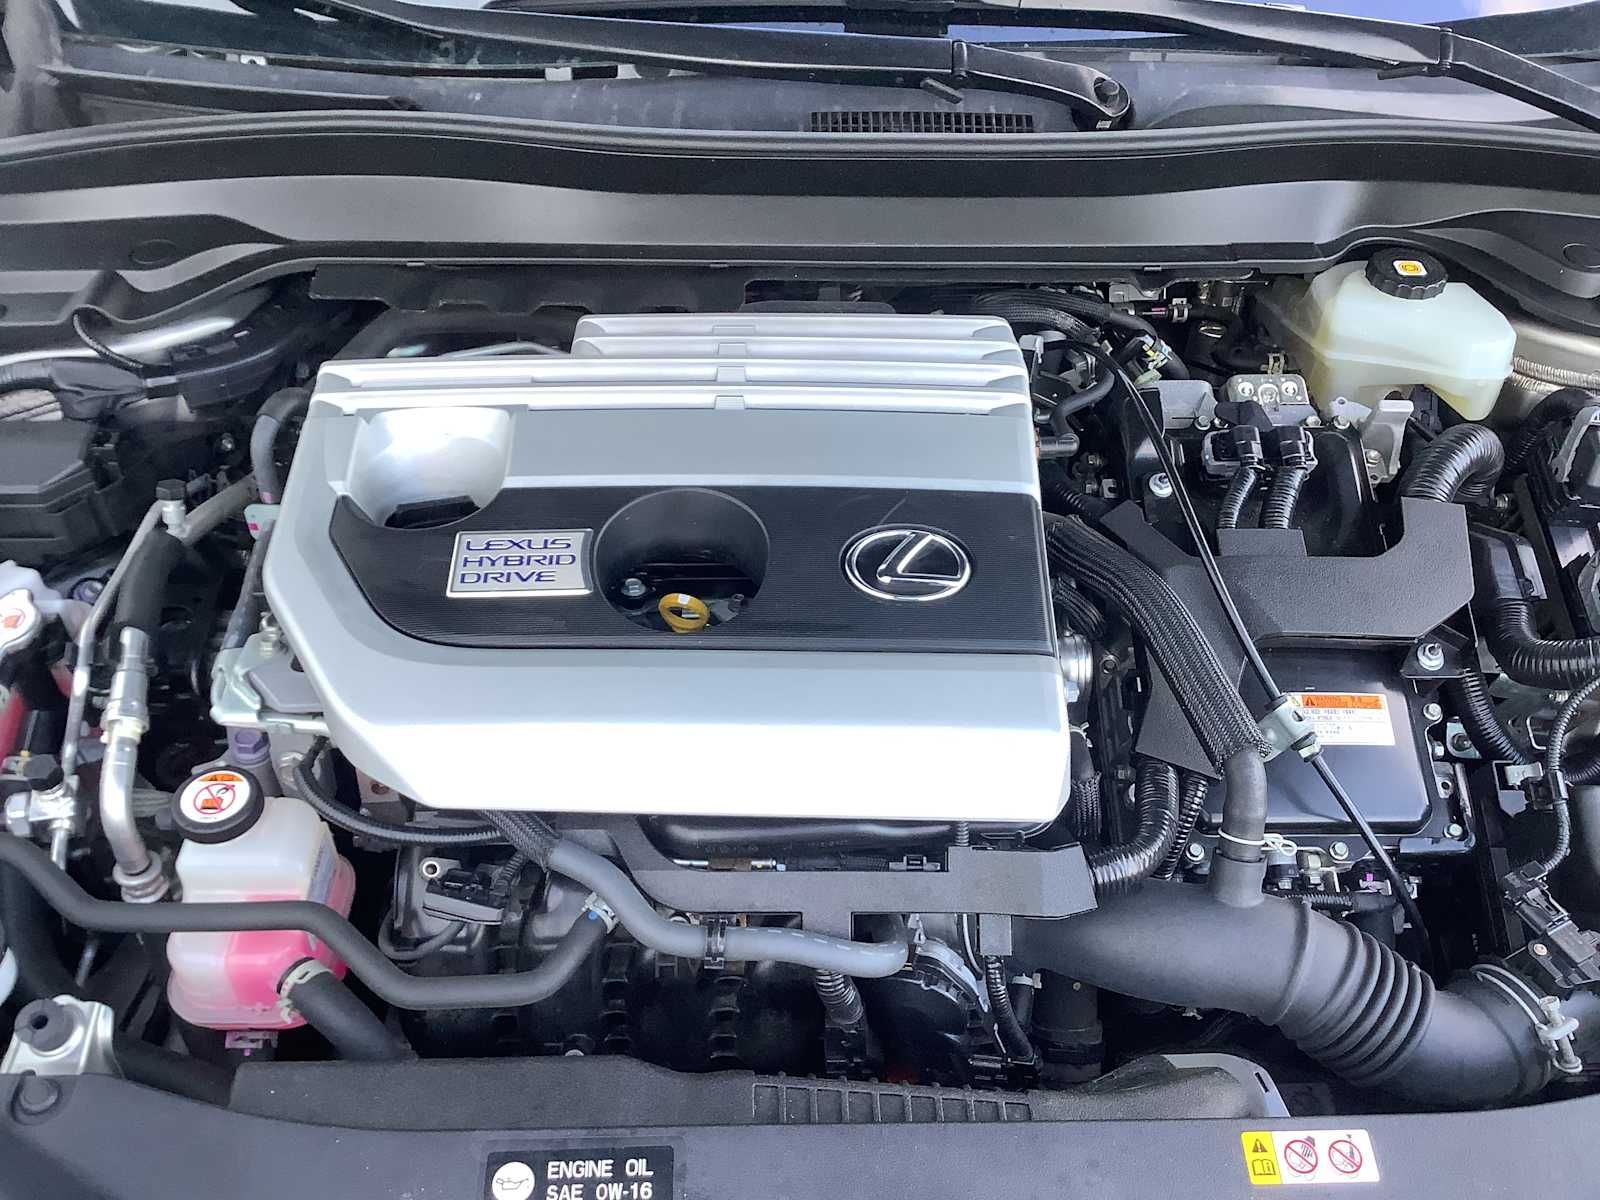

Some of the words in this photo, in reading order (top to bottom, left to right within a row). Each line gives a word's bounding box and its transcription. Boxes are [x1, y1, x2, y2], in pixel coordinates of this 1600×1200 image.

[466, 538, 572, 550] LEXUS
[462, 554, 577, 567] HYBRID
[460, 571, 556, 584] DRIVE
[547, 1159, 614, 1179] ENGINE
[625, 1158, 654, 1177] OIL
[546, 1184, 584, 1200] SAE
[596, 1181, 653, 1200] 0W-16
